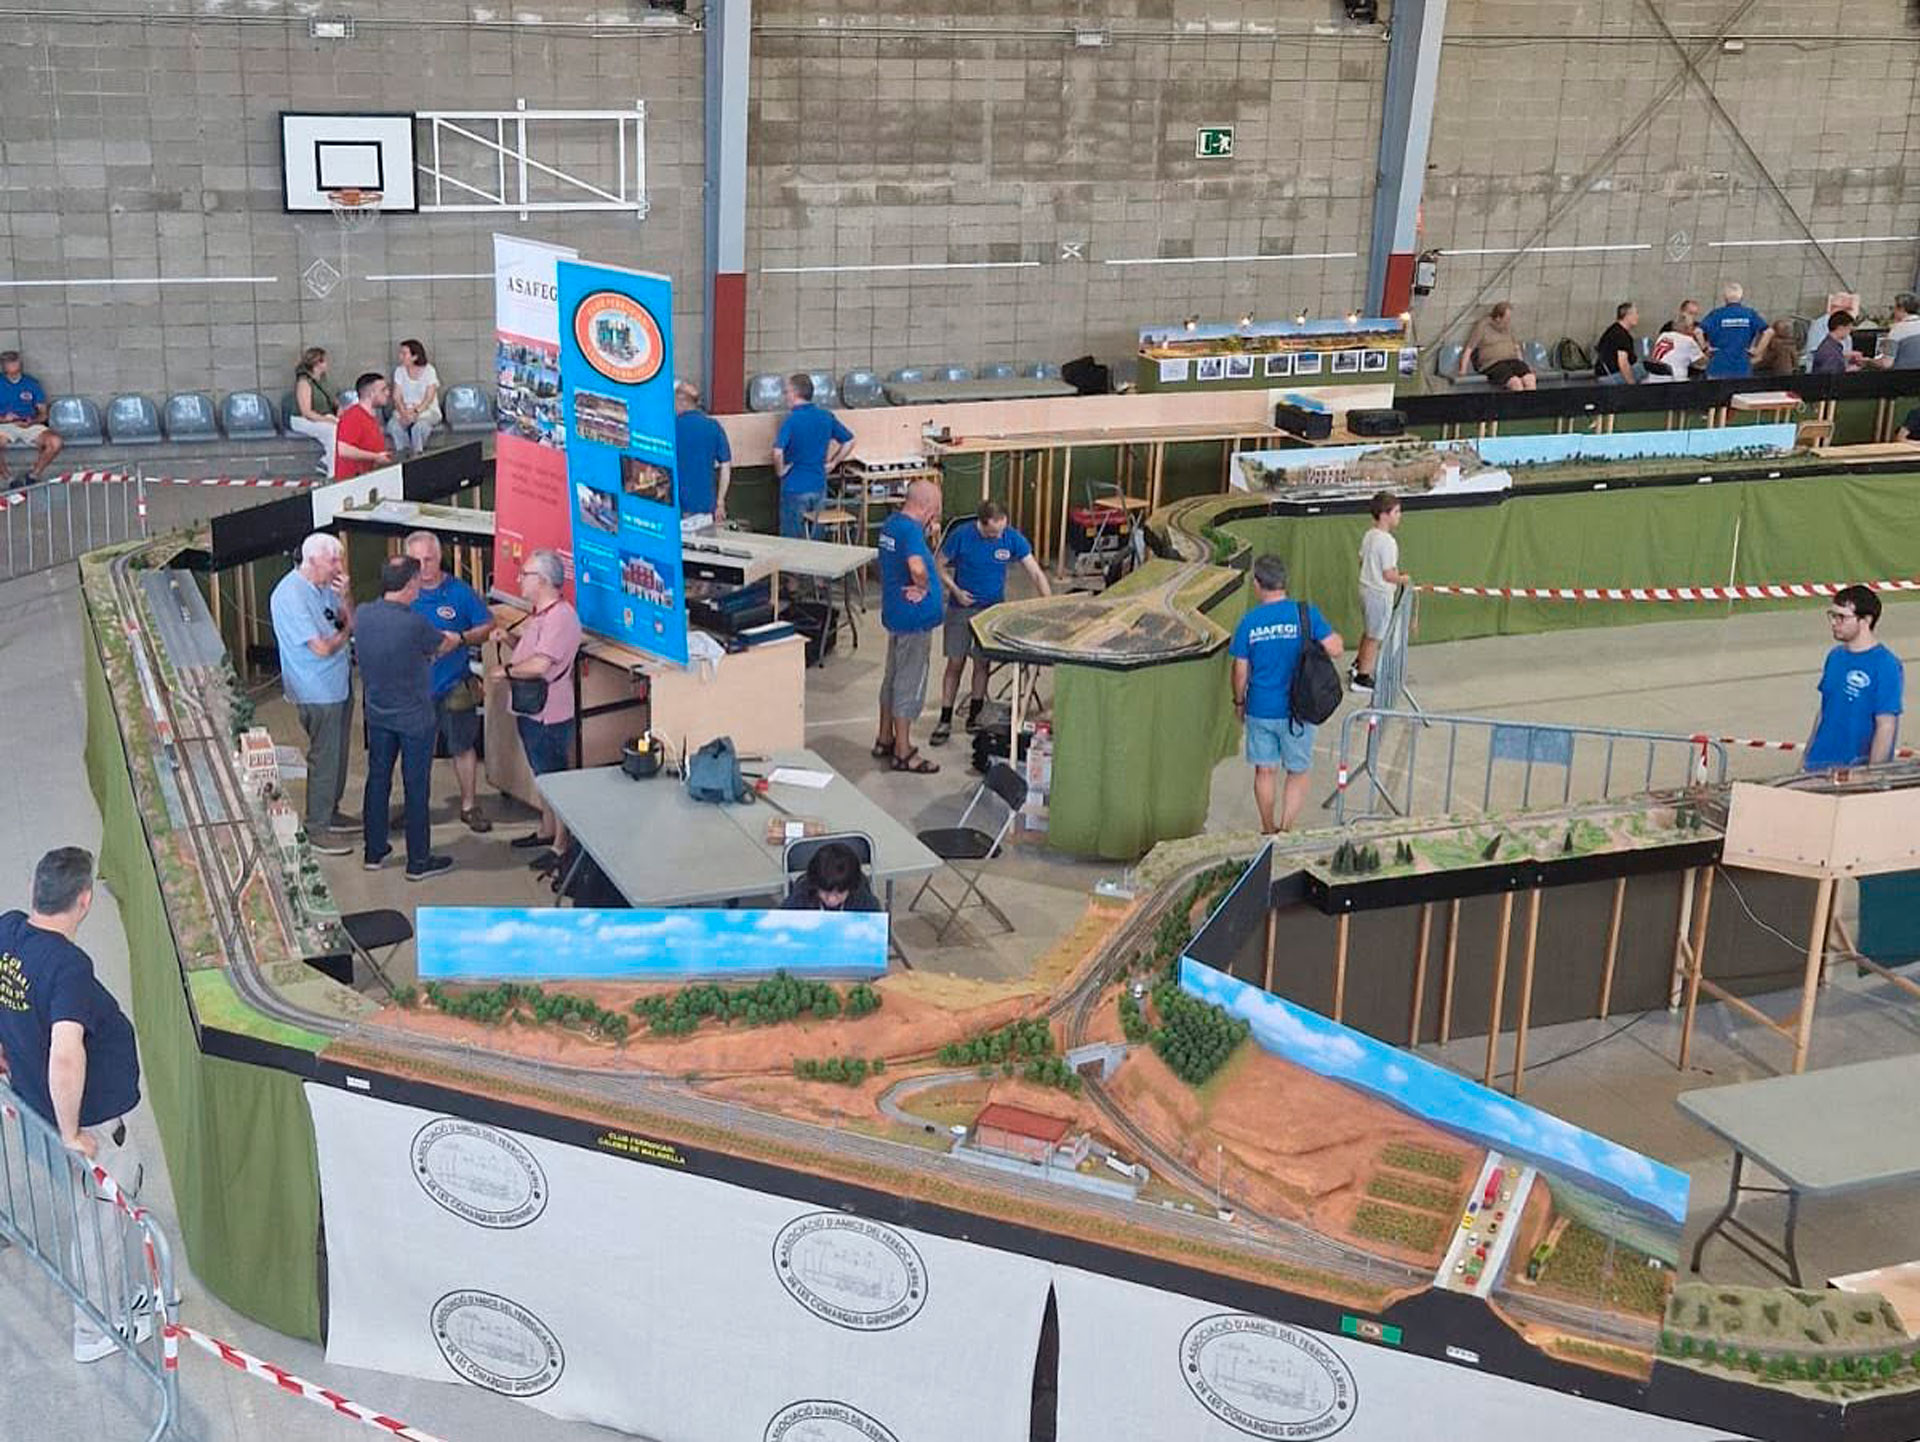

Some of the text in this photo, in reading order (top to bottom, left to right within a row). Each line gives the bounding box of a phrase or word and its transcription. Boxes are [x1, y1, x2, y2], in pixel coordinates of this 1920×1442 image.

[507, 276, 558, 302] ASAFEG
[1249, 623, 1297, 637] ASAFEGI
[866, 1224, 881, 1239] DEL
[786, 1276, 797, 1289] DE
[796, 1287, 810, 1302] LES
[1188, 1319, 1234, 1362] ASSOCIACIÓ
[1279, 1328, 1297, 1345] DEL
[1195, 1380, 1208, 1396] DE
[1206, 1395, 1222, 1410] LES
[1222, 1407, 1285, 1437] COMARQUES
